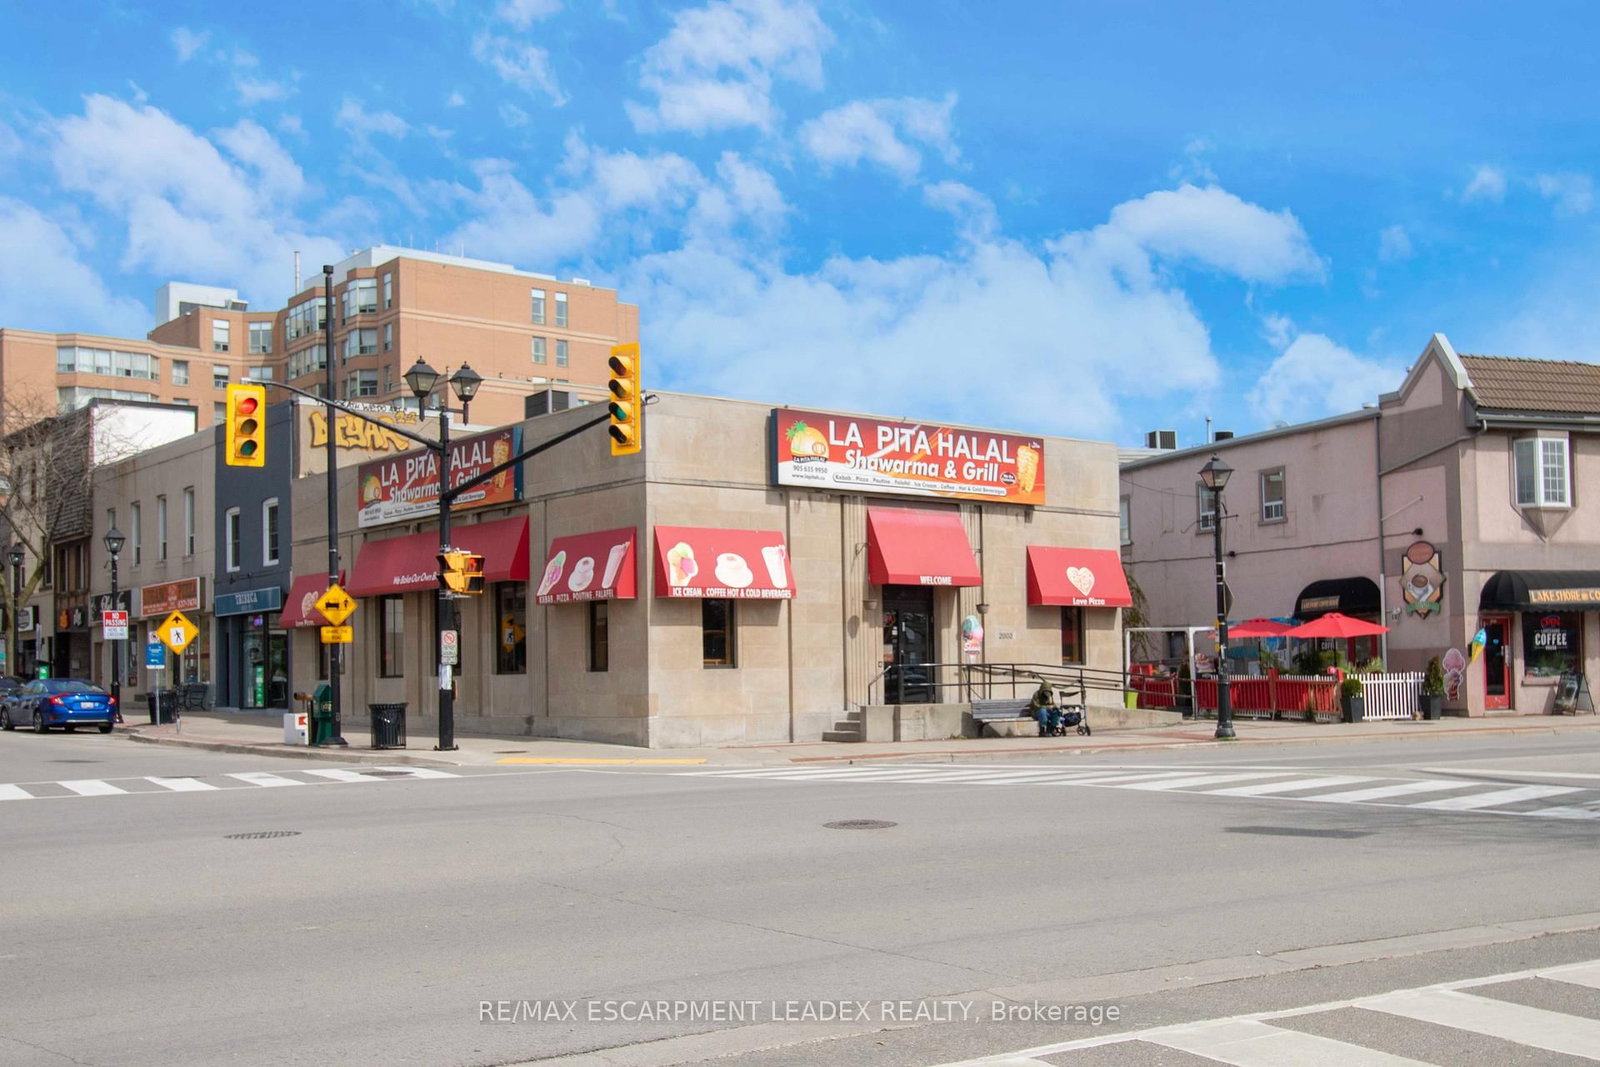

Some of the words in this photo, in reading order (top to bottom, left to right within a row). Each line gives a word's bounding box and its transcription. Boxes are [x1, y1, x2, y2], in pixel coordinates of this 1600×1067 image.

[829, 420, 865, 449] LA
[877, 425, 932, 455] PITA
[937, 432, 1015, 464] HALAL
[381, 462, 400, 487] LA
[406, 453, 437, 481] PITA
[450, 440, 492, 472] ALAL
[845, 448, 939, 478] Shawarma
[944, 460, 958, 479] &
[962, 461, 999, 482] Grill
[920, 575, 952, 585] WELCOME
[539, 594, 554, 604] KABAB
[556, 592, 570, 602] PIZZA
[573, 590, 592, 601] POUTINE
[595, 588, 614, 599] FALAFEL
[672, 587, 682, 597] ICE
[683, 587, 702, 597] CREAM
[706, 587, 726, 597] COFFEE
[726, 588, 739, 598] HOT
[740, 588, 745, 598] &
[746, 588, 761, 598] COLD
[761, 588, 792, 599] BEVERAGES
[1531, 590, 1582, 602] LAKESHORE
[1072, 597, 1088, 606] Love
[1088, 597, 1105, 606] Pizza
[111, 612, 120, 620] NO
[1535, 632, 1568, 646] COFFEE
